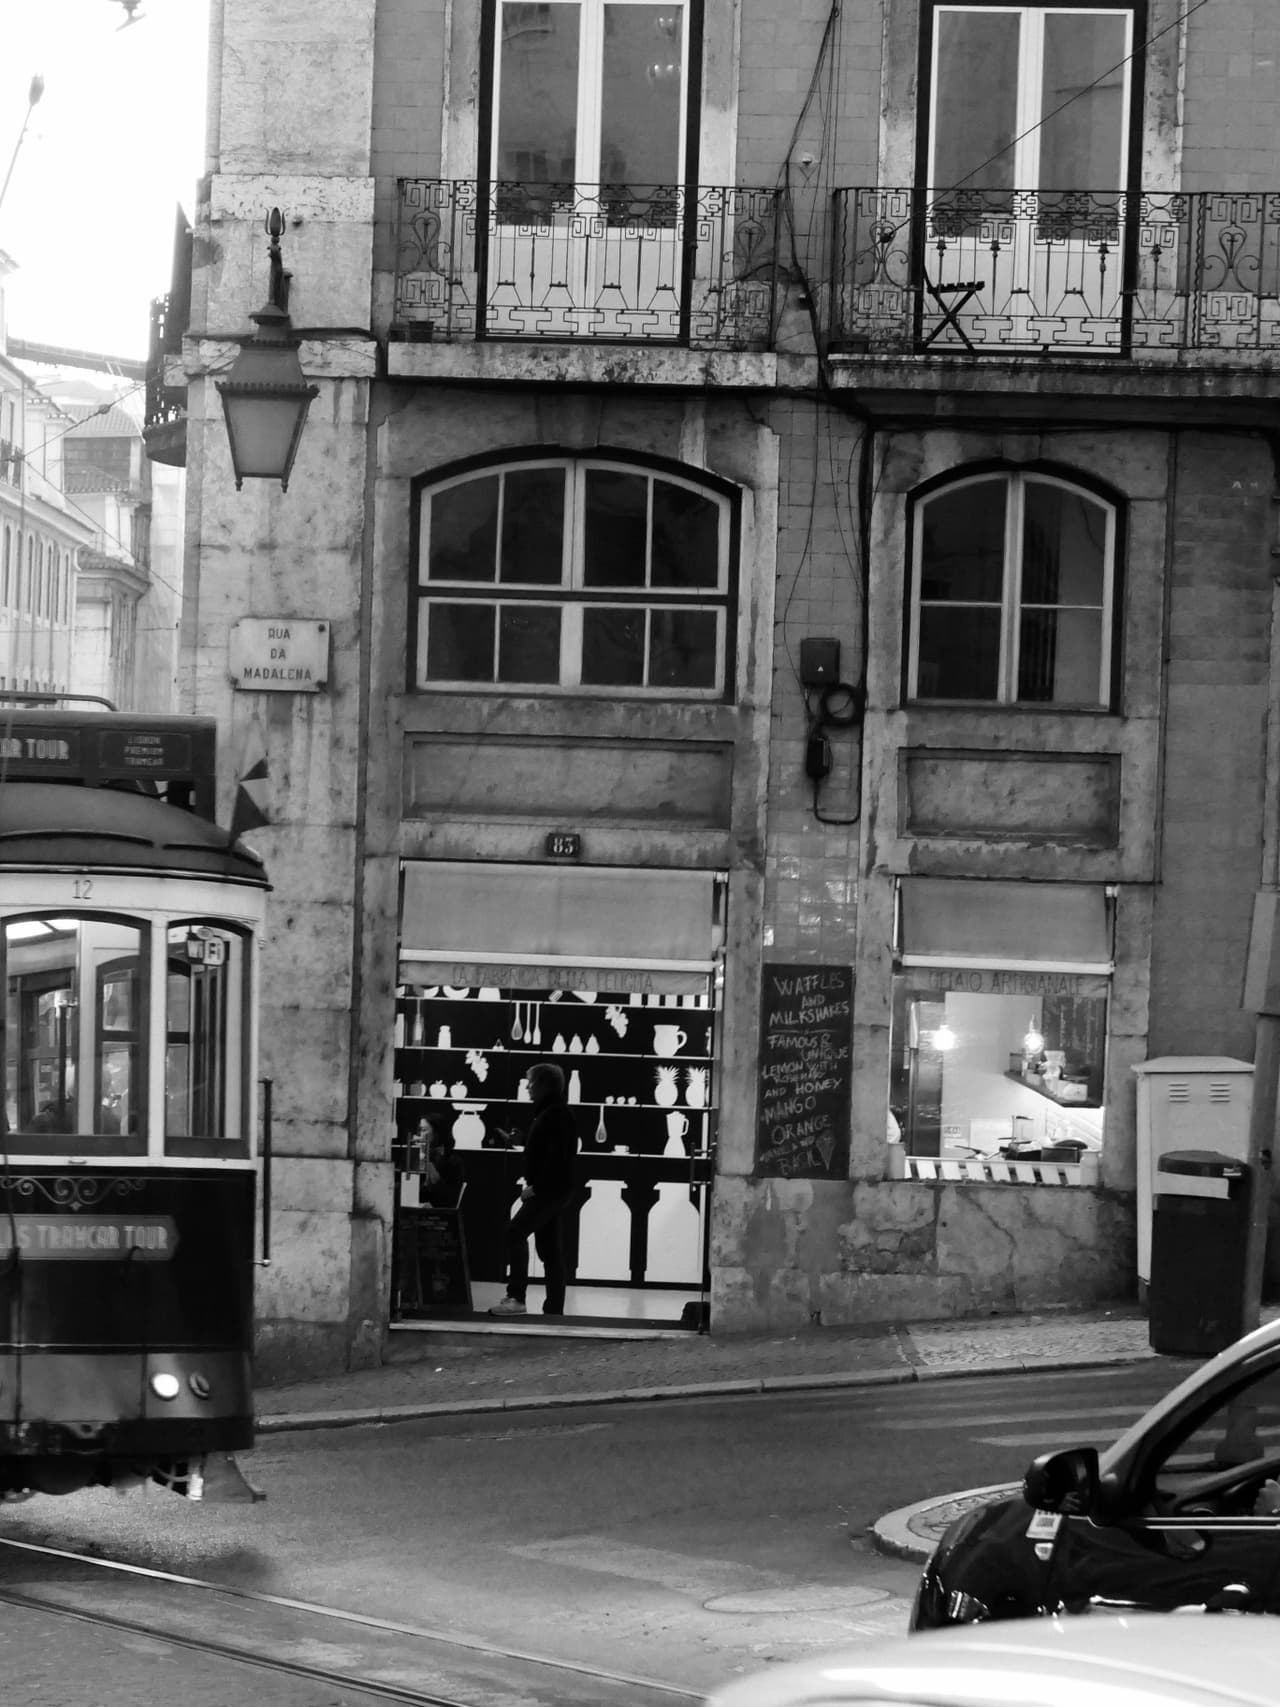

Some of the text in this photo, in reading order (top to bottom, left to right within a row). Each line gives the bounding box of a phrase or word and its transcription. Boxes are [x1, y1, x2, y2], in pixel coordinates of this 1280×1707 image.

[268, 627, 291, 640] RUA
[270, 648, 286, 660] DA
[243, 667, 312, 681] MADALENA
[26, 738, 69, 760] TOUR
[72, 879, 93, 900] 12
[773, 971, 845, 996] WAFFLES
[801, 994, 825, 1009] AND
[769, 1000, 850, 1027] MILKSHAKES
[768, 1034, 818, 1049] FAMOUS
[761, 1060, 804, 1080] LEMON
[795, 1078, 842, 1095] HONEY
[764, 1096, 817, 1126] MANGO
[772, 1114, 833, 1146] ORANGE
[36, 1224, 120, 1249] TRAMCAR
[123, 1225, 169, 1250] TOUR
